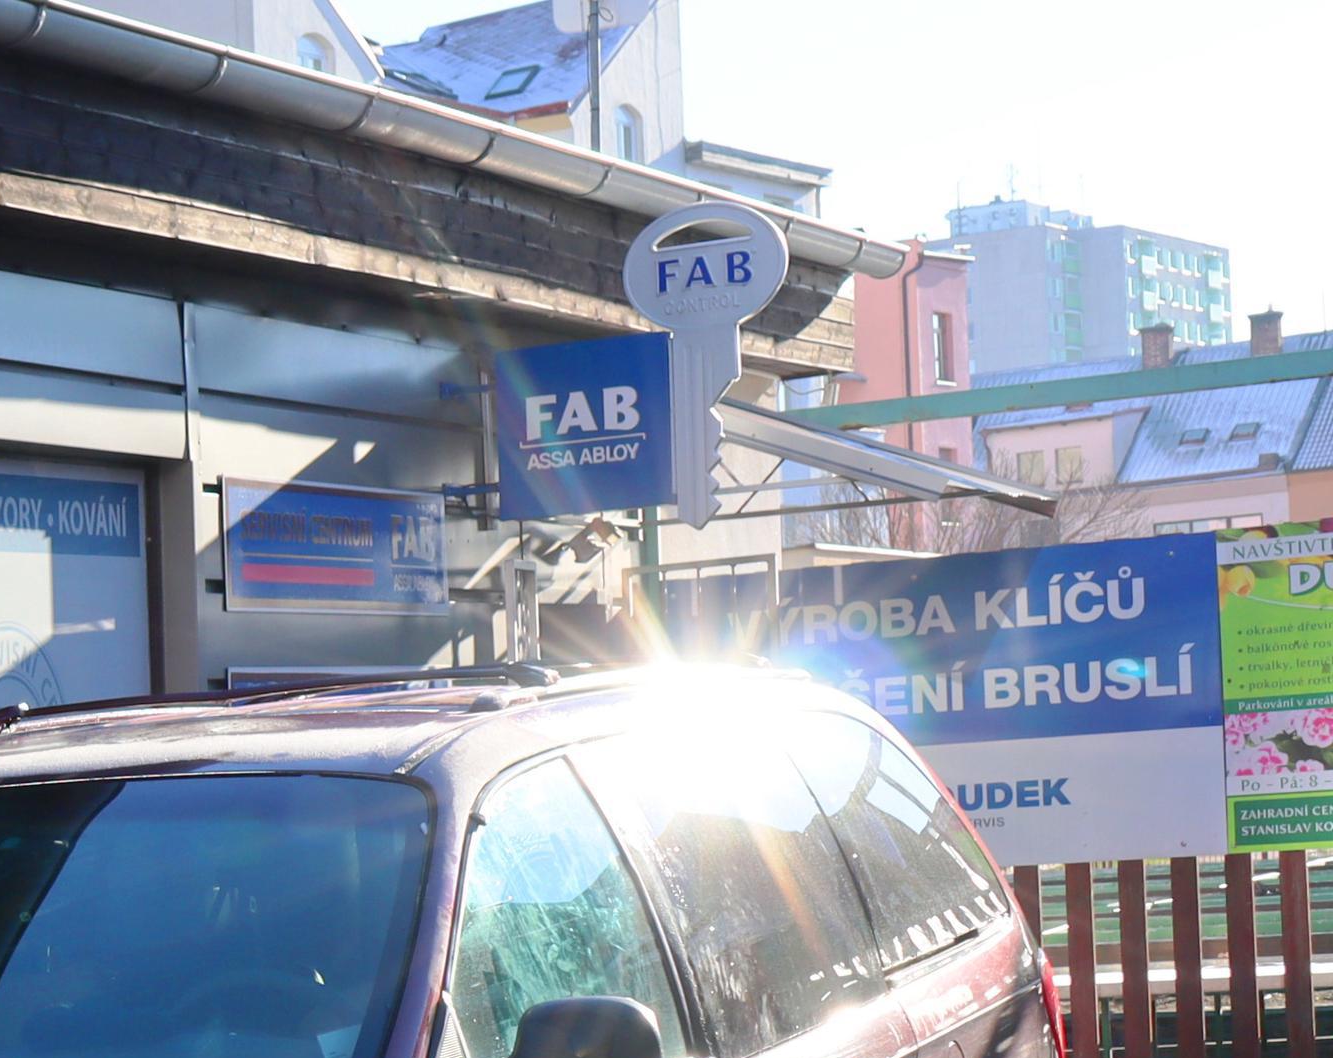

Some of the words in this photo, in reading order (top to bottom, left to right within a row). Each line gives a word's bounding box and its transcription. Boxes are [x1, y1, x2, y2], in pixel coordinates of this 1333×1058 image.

[658, 251, 752, 293] FAB
[525, 386, 640, 441] FAB
[527, 451, 575, 471] ASSA
[579, 443, 639, 465] ABLOY
[58, 496, 127, 537] KOVÁNÍ
[310, 514, 373, 547] CENTRUM
[391, 514, 437, 562] FAB
[1233, 537, 1333, 560] NAVŠTIVT
[1289, 560, 1333, 597] D
[975, 566, 1145, 631] KLÍČŮ
[1246, 623, 1293, 636] okrasné
[983, 643, 1195, 709] BRUSLÍ
[1248, 660, 1293, 673] trvalky,
[1248, 678, 1303, 692] pokojové
[1238, 698, 1294, 711] Parkování
[946, 778, 1071, 811] UDEK
[1241, 779, 1261, 792] Po
[1280, 775, 1303, 790] Pá:
[1309, 774, 1318, 788] 8
[970, 817, 1005, 828] RVIS
[1240, 804, 1308, 821] ZAHRADNÍ
[1241, 823, 1312, 837] STANISLAV
